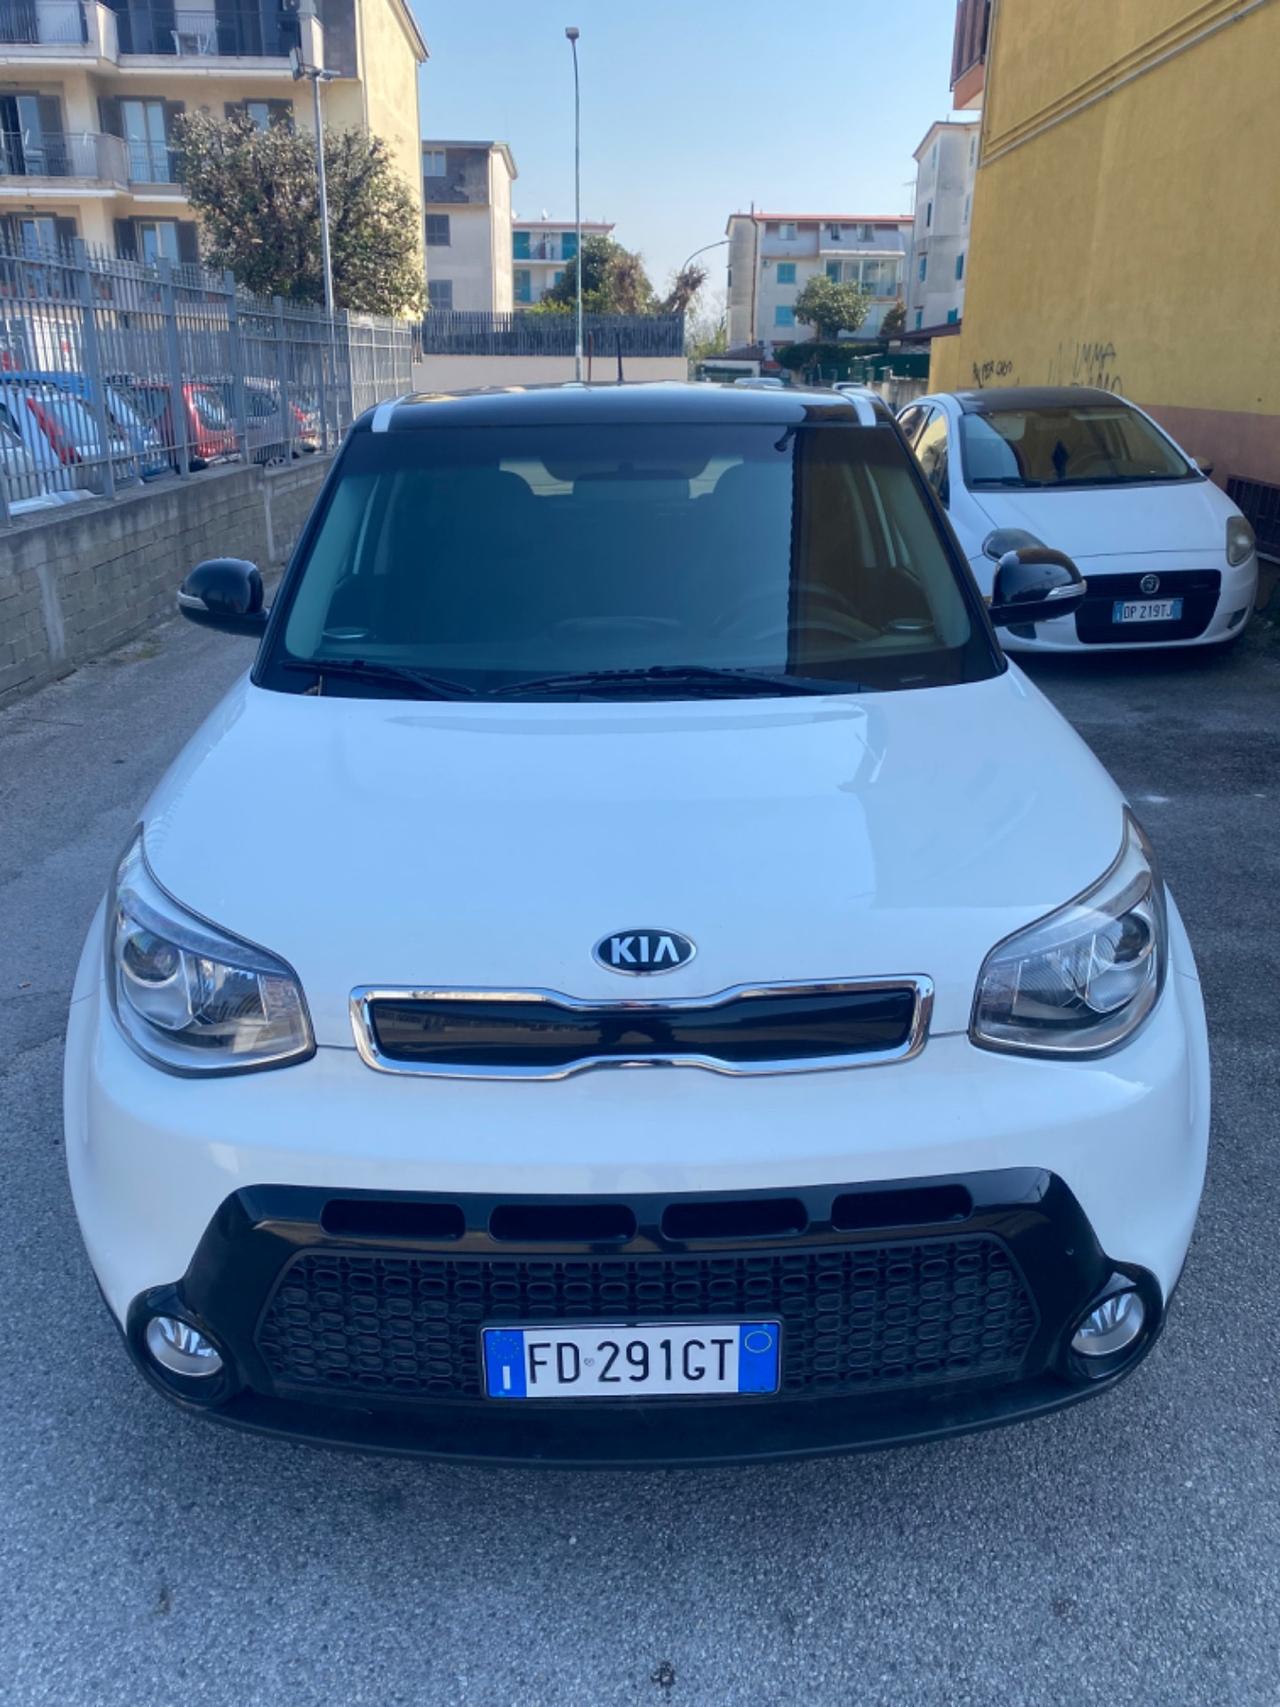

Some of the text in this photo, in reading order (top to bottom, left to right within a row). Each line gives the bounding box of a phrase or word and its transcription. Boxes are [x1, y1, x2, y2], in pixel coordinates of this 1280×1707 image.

[611, 935, 680, 964] KIA
[528, 1339, 734, 1384] FD 291GT
